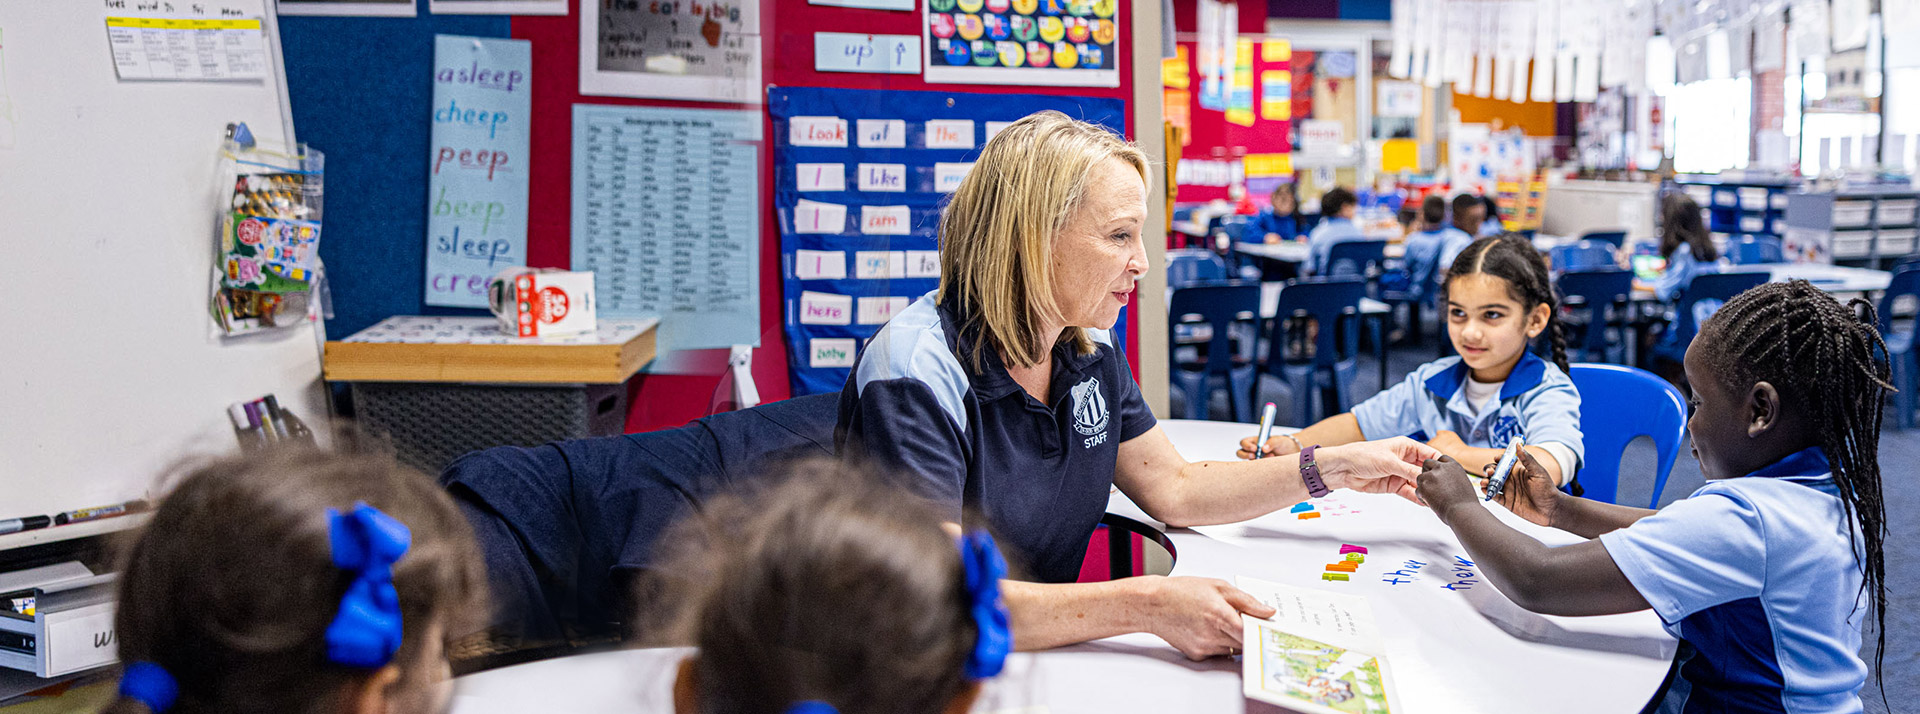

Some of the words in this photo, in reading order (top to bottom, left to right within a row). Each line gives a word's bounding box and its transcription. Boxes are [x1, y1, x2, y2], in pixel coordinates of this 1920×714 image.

[845, 45, 873, 66] up
[437, 61, 523, 92] asleep
[435, 98, 508, 139] cheep
[870, 124, 889, 142] at
[435, 146, 508, 180] peep
[869, 168, 899, 186] like
[433, 185, 505, 235] beep
[869, 214, 897, 226] am
[436, 226, 511, 267] sleep
[867, 258, 887, 274] go
[920, 255, 936, 273] to
[807, 302, 842, 318] here
[1084, 431, 1108, 449] STAFF
